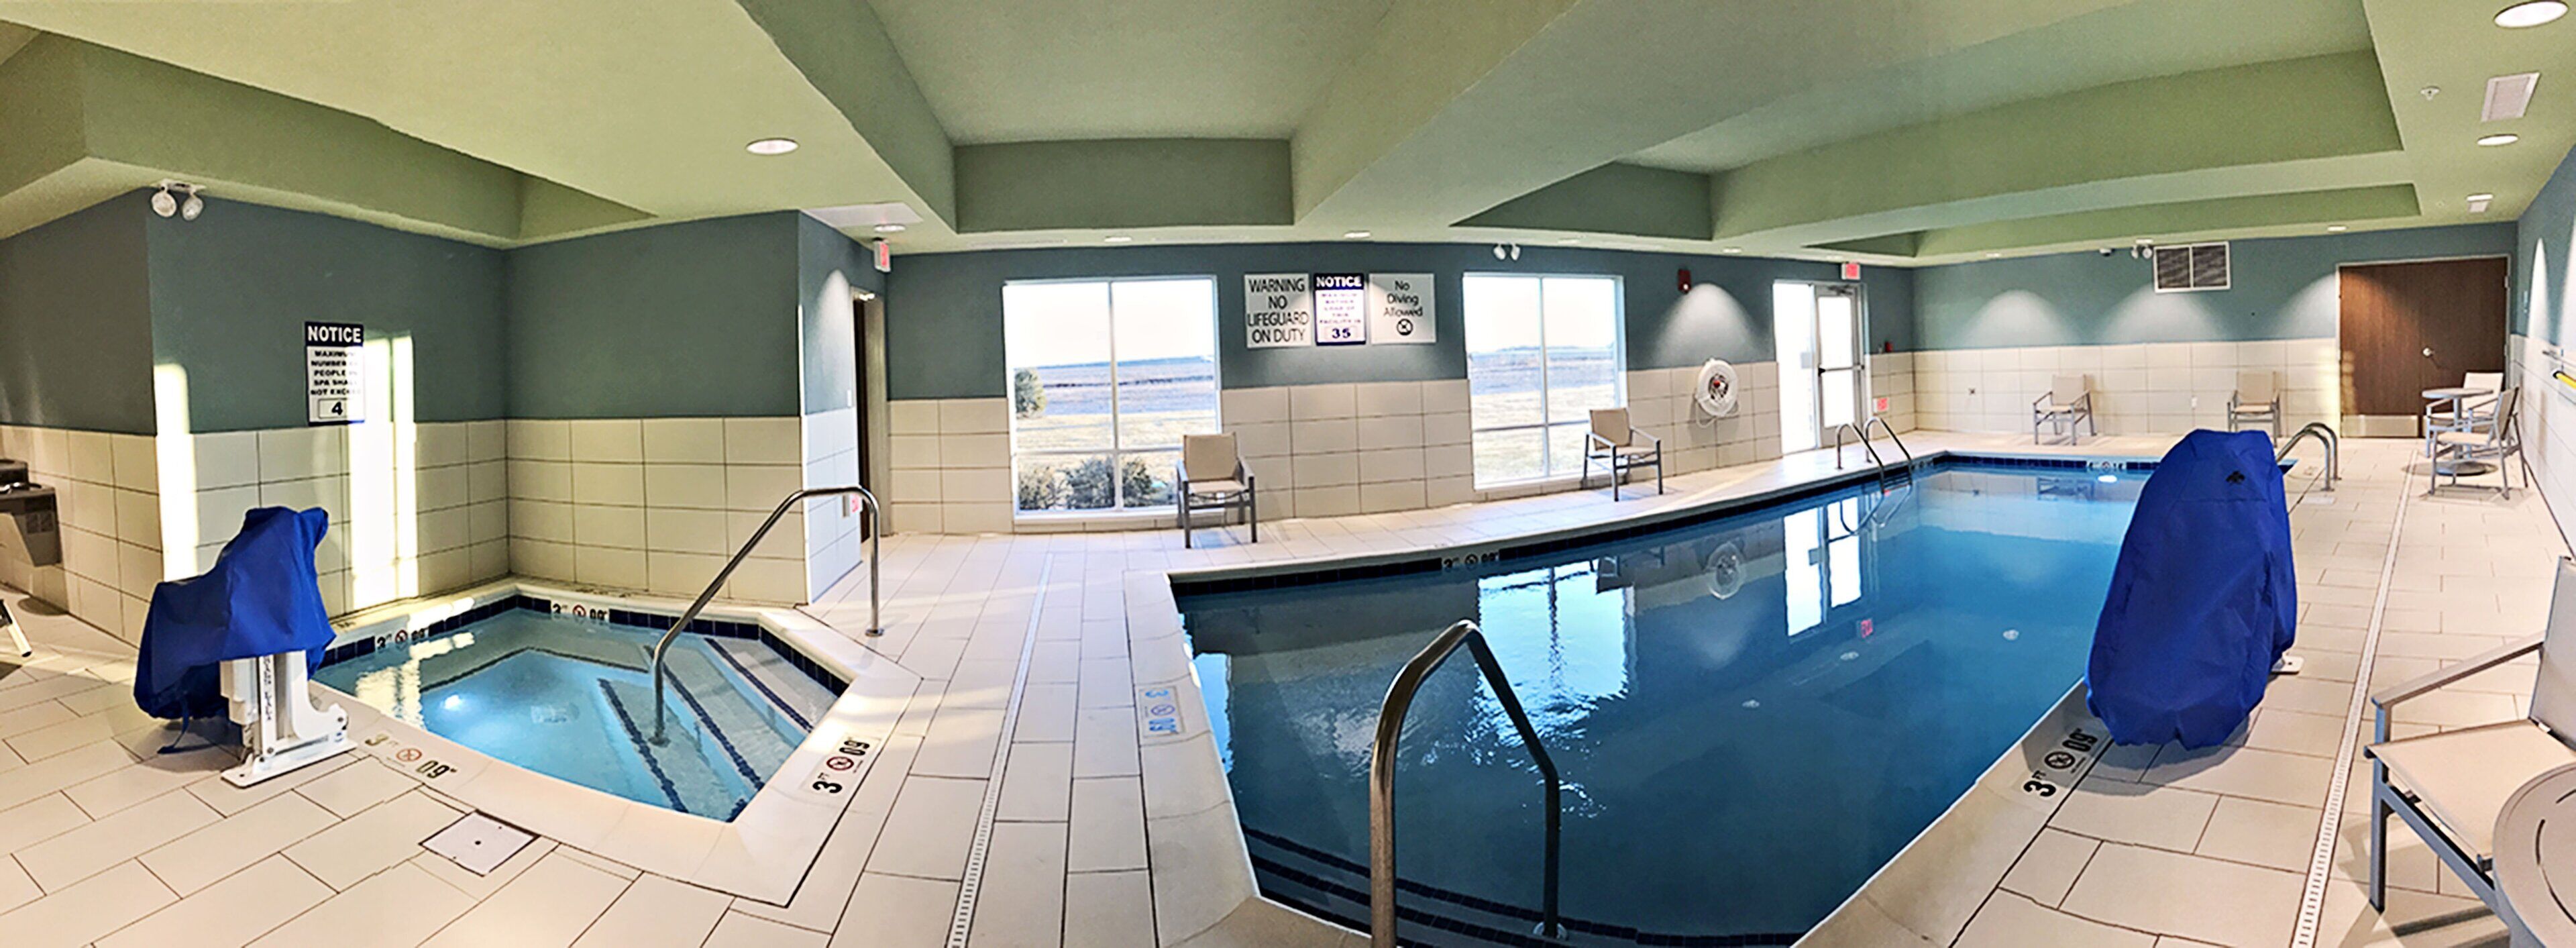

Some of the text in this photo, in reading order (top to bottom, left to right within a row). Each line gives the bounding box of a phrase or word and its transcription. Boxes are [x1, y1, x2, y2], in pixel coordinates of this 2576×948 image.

[1249, 278, 1305, 293] WARNING
[1316, 276, 1362, 288] NOTICE
[1395, 280, 1410, 291] No
[1269, 295, 1287, 309] NO
[1387, 293, 1419, 307] Diving
[1384, 306, 1424, 317] Allowed
[1248, 311, 1309, 327] LIFEGUARD
[307, 325, 362, 344] NOTICE
[1252, 329, 1305, 343] ON DUTY
[1332, 327, 1351, 339] 35
[315, 350, 356, 358] MAXIMU
[331, 401, 343, 416] 4
[812, 781, 843, 794] 3
[2023, 780, 2056, 797] 3
